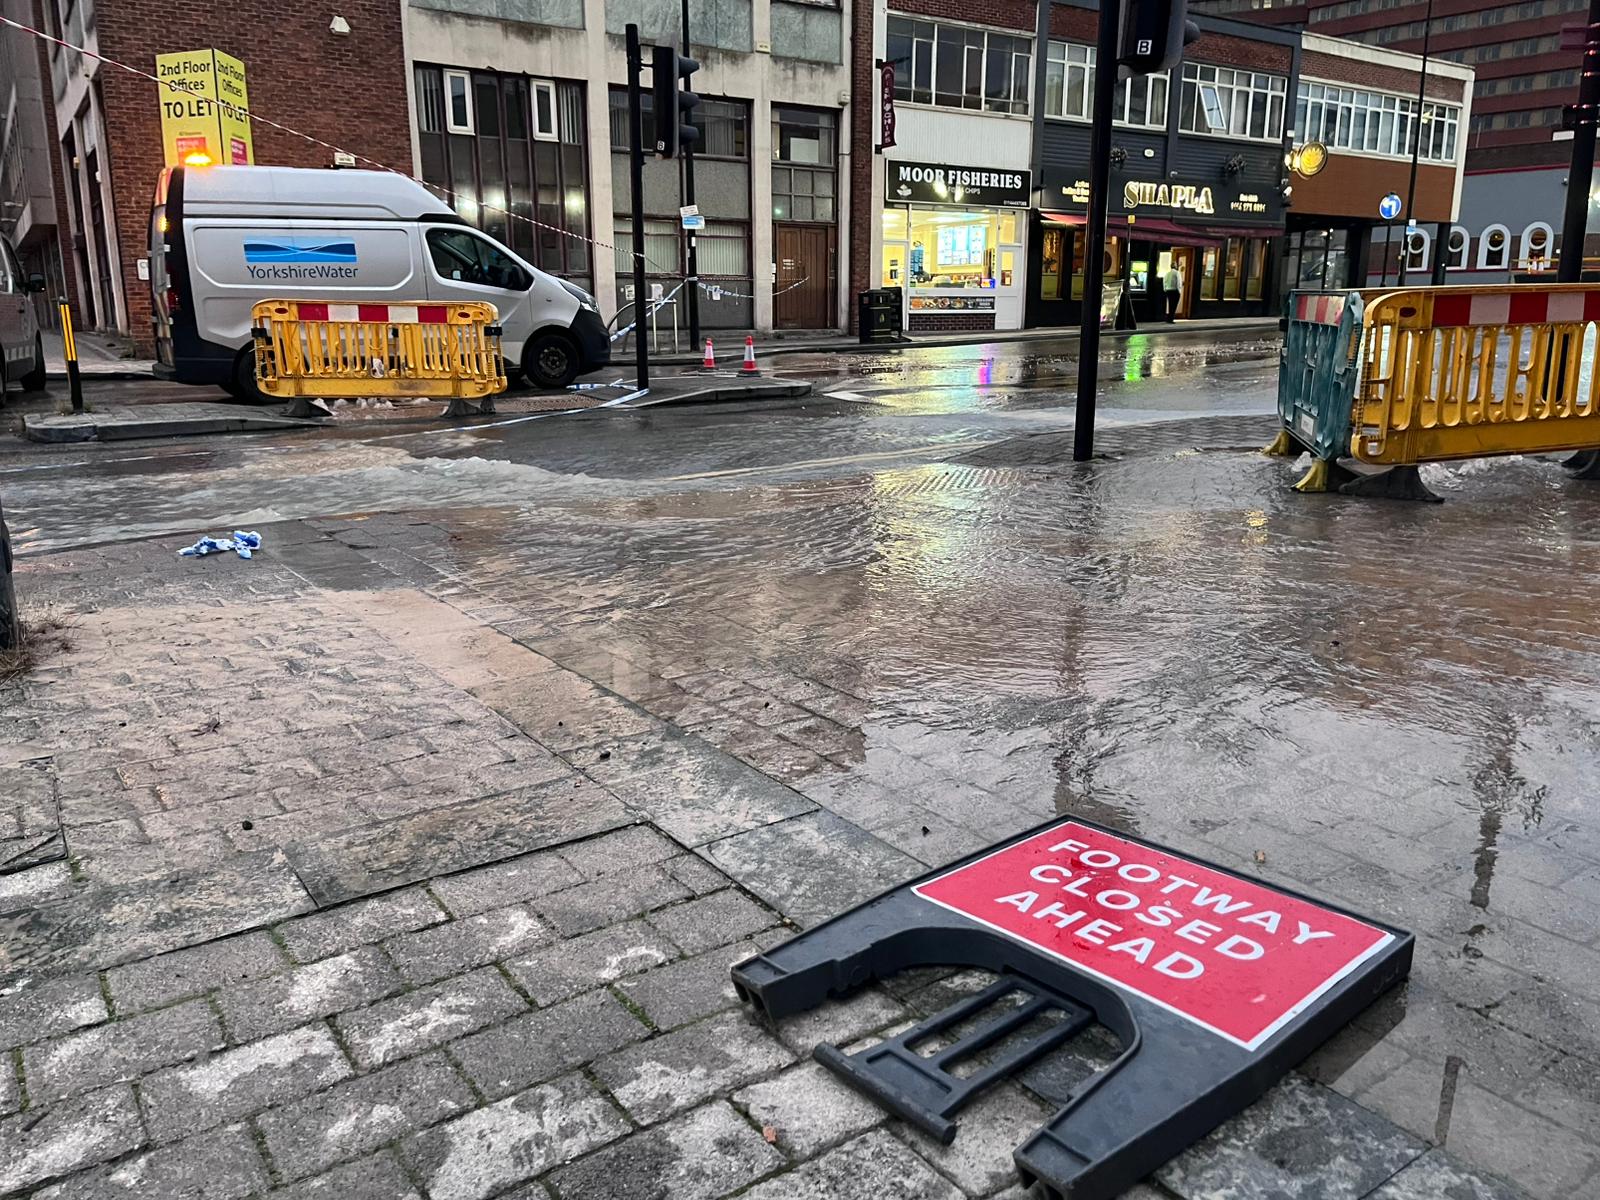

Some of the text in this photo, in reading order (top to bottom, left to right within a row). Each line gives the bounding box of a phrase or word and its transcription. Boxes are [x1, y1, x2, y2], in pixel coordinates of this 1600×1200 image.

[1139, 40, 1149, 53] B
[160, 61, 211, 76] 2nd Floor
[217, 60, 244, 82] 2nd Floor
[169, 78, 205, 92] Offices
[222, 79, 243, 98] Offices
[164, 100, 212, 118] TO LET
[220, 98, 248, 124] TO LET
[899, 165, 1022, 190] MOOR FISHERIES
[1123, 180, 1215, 214] SHAPLA
[1047, 837, 1336, 946] FOOTWAY
[1028, 864, 1266, 962] CLOSED
[994, 890, 1206, 981] AHEAD
